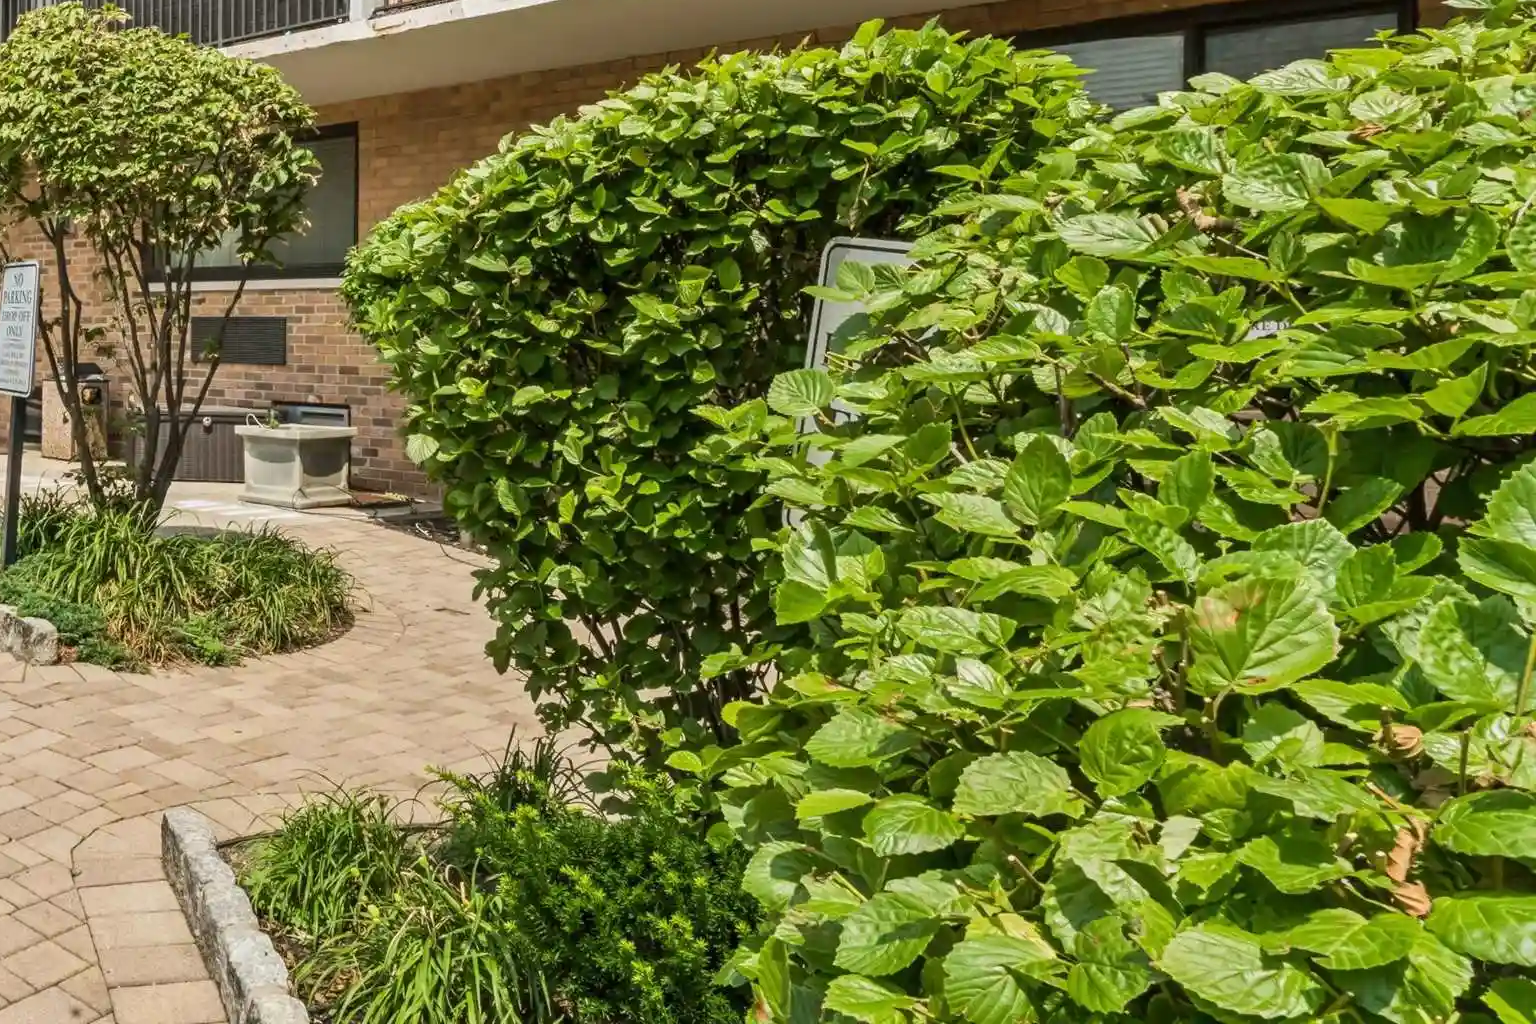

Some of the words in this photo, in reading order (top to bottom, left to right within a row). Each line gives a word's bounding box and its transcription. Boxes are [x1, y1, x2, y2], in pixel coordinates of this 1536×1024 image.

[14, 272, 24, 288] NO
[3, 289, 32, 304] PARKING
[18, 311, 31, 322] OFF
[6, 325, 23, 337] ONLY
